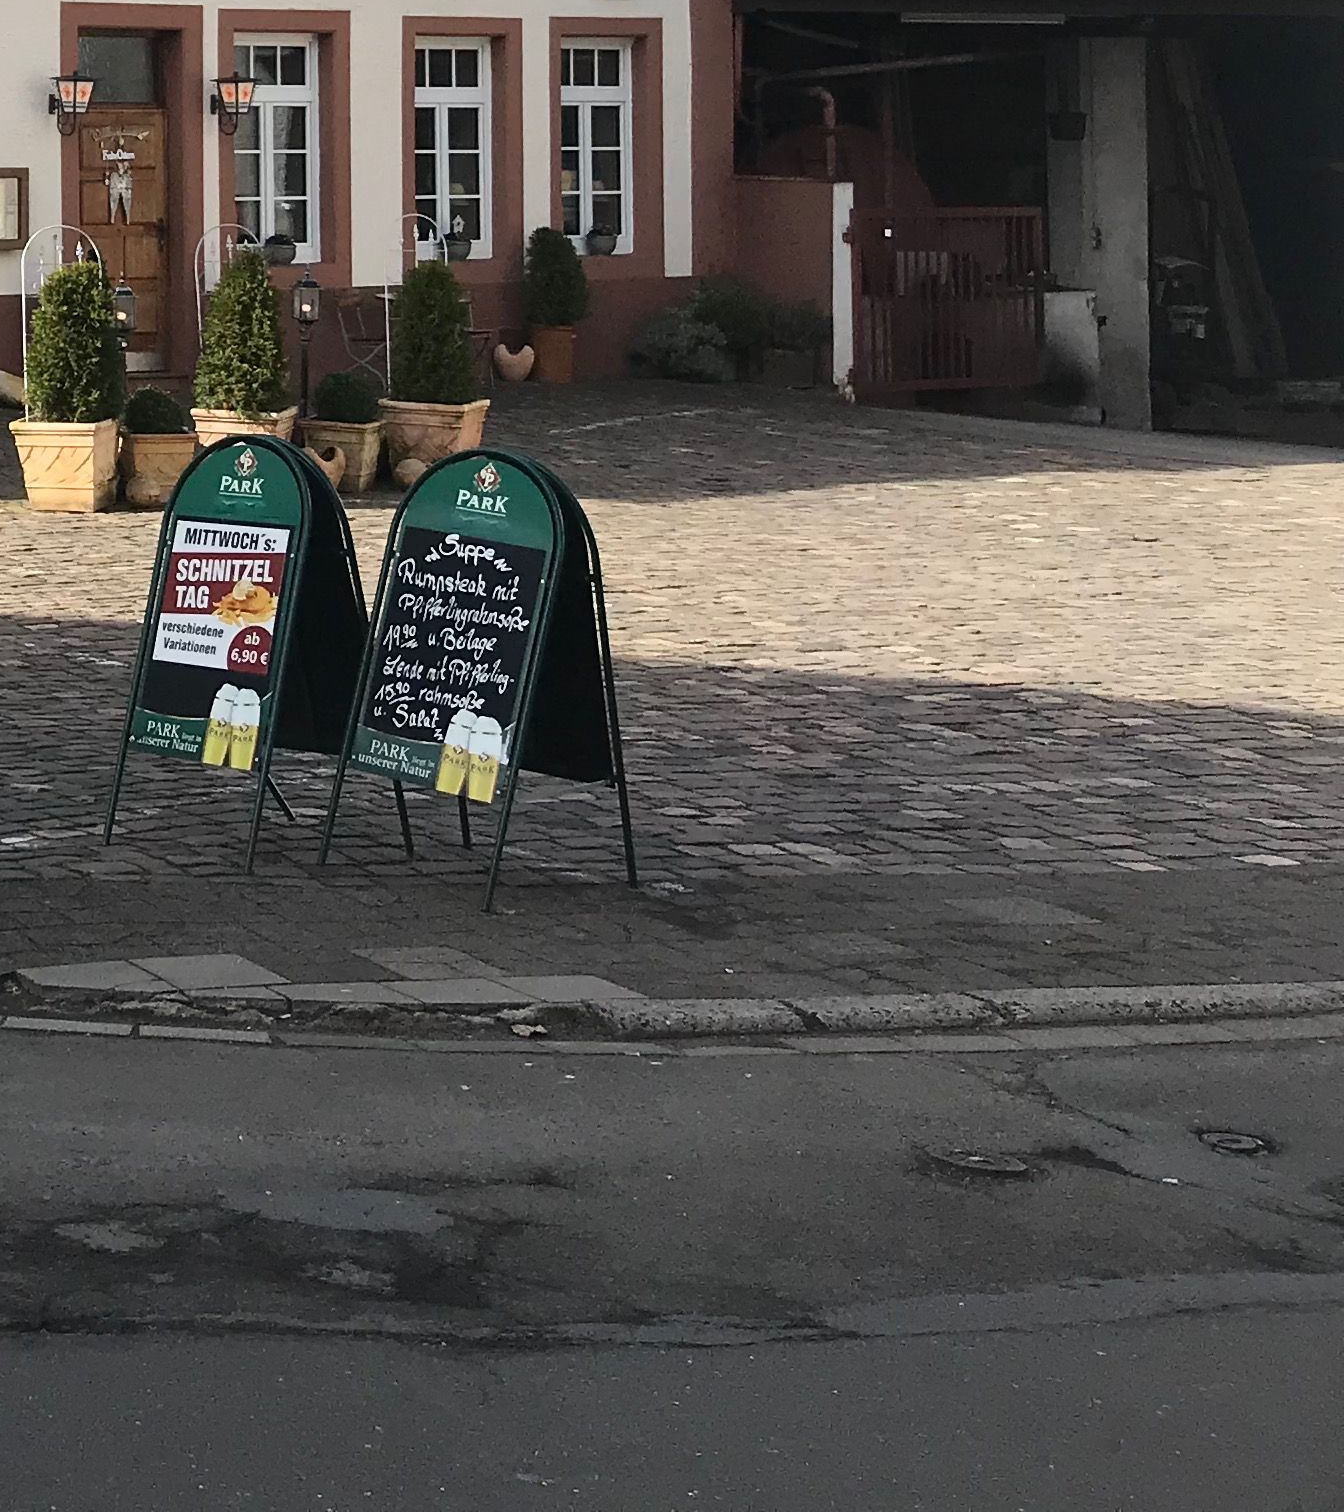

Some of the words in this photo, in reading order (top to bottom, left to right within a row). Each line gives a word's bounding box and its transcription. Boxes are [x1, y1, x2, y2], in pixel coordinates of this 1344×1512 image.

[219, 475, 265, 494] PARK
[456, 489, 509, 513] PARK
[439, 533, 495, 566] Suppe
[176, 558, 273, 582] SCHNITZEL
[398, 558, 487, 599] Rumpsteak
[492, 575, 520, 601] mit
[175, 585, 210, 609] TAG
[162, 621, 224, 638] verschiedene
[243, 632, 261, 646] ab
[163, 637, 216, 655] Variationen
[428, 633, 440, 647] u.
[440, 628, 498, 660] Beilage
[231, 648, 257, 664] 6,90
[260, 652, 269, 665] €
[383, 655, 424, 680] Lende
[427, 655, 448, 681] mit
[374, 706, 387, 717] u.
[392, 703, 440, 728] Salat
[146, 720, 181, 738] PARK
[171, 739, 199, 753] Natur
[370, 739, 410, 762] PARK
[358, 752, 398, 770] unserer
[400, 761, 432, 778] Natur
